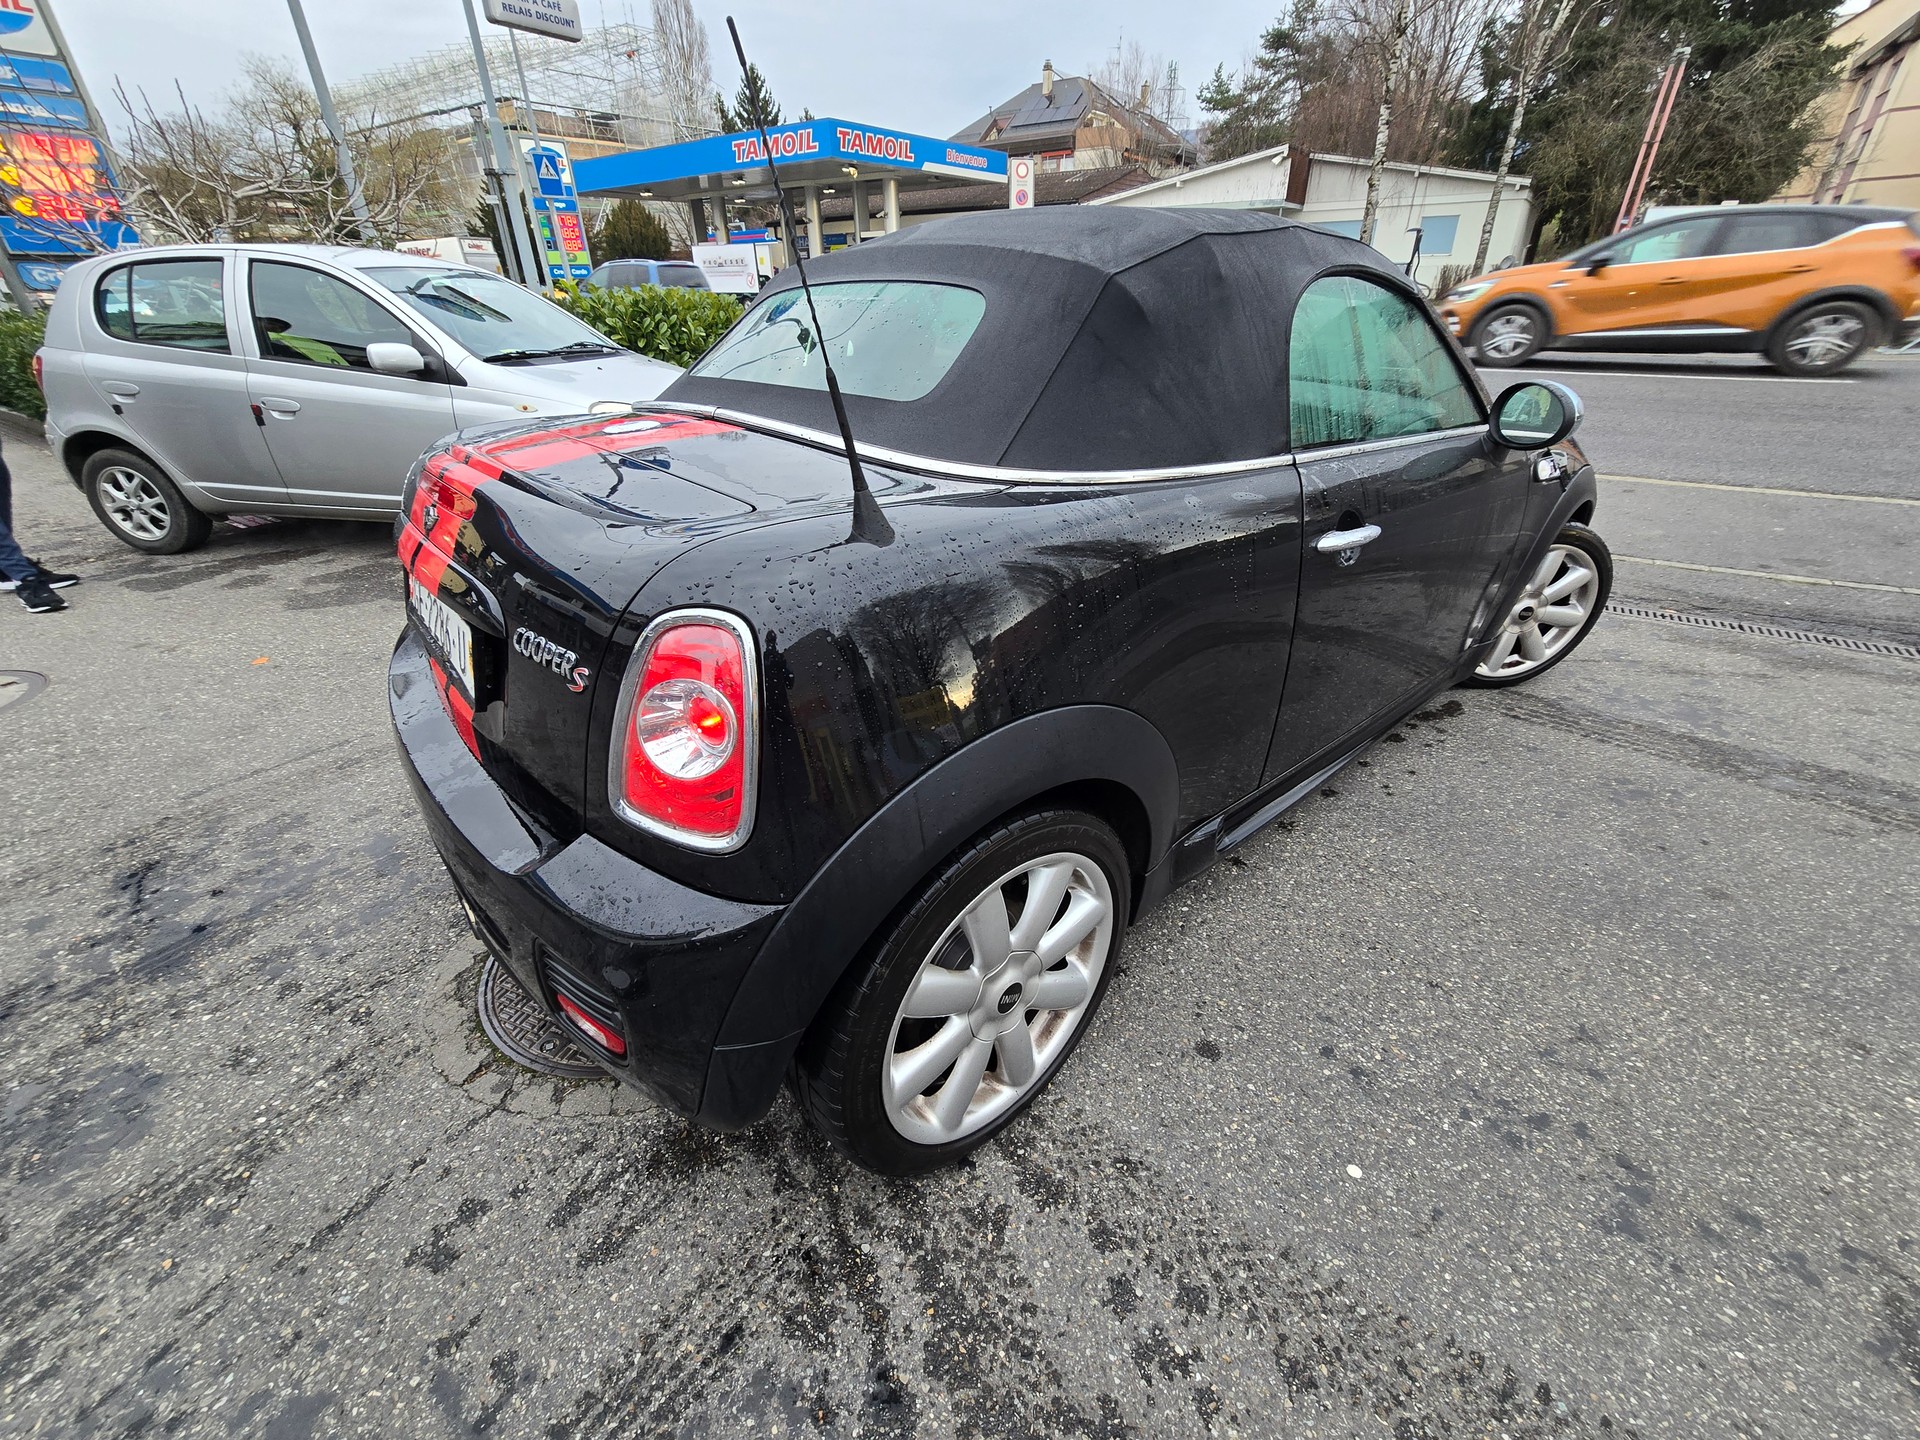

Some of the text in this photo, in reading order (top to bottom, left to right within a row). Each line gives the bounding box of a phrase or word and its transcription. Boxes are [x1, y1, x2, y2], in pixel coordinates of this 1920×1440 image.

[501, 2, 575, 29] RELAIS DISCOUNT
[732, 129, 819, 163] TAMOIL
[836, 127, 914, 162] TAMOIL
[946, 148, 988, 169] Bienvenue
[513, 627, 589, 692] COOPER S
